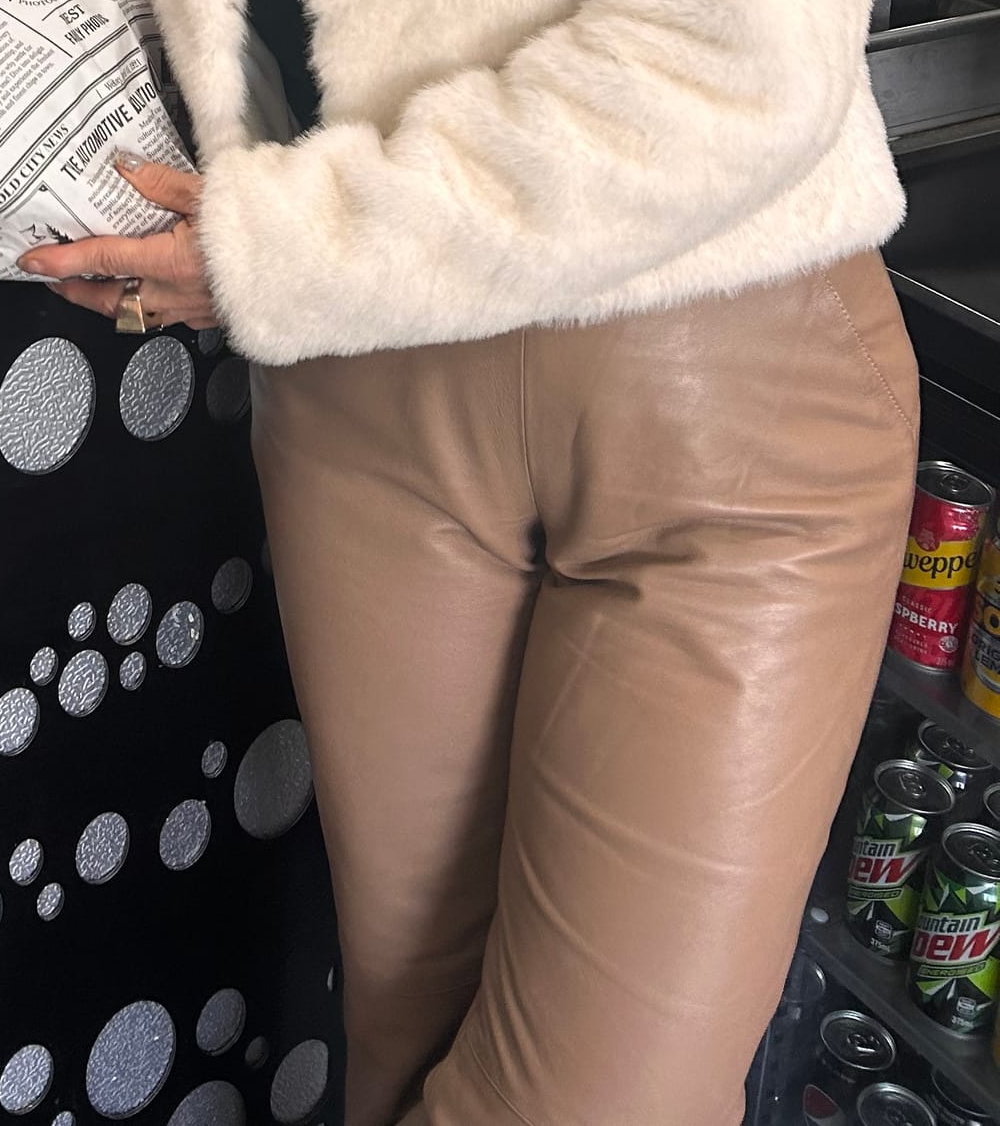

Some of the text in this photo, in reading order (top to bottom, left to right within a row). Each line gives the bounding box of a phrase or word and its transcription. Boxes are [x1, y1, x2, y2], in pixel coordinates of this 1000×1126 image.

[19, 149, 46, 178] CITY
[41, 124, 70, 155] NEWS
[75, 104, 134, 168] AUTOMOTIVE
[903, 549, 977, 579] weppe
[896, 602, 959, 635] SPBERRY
